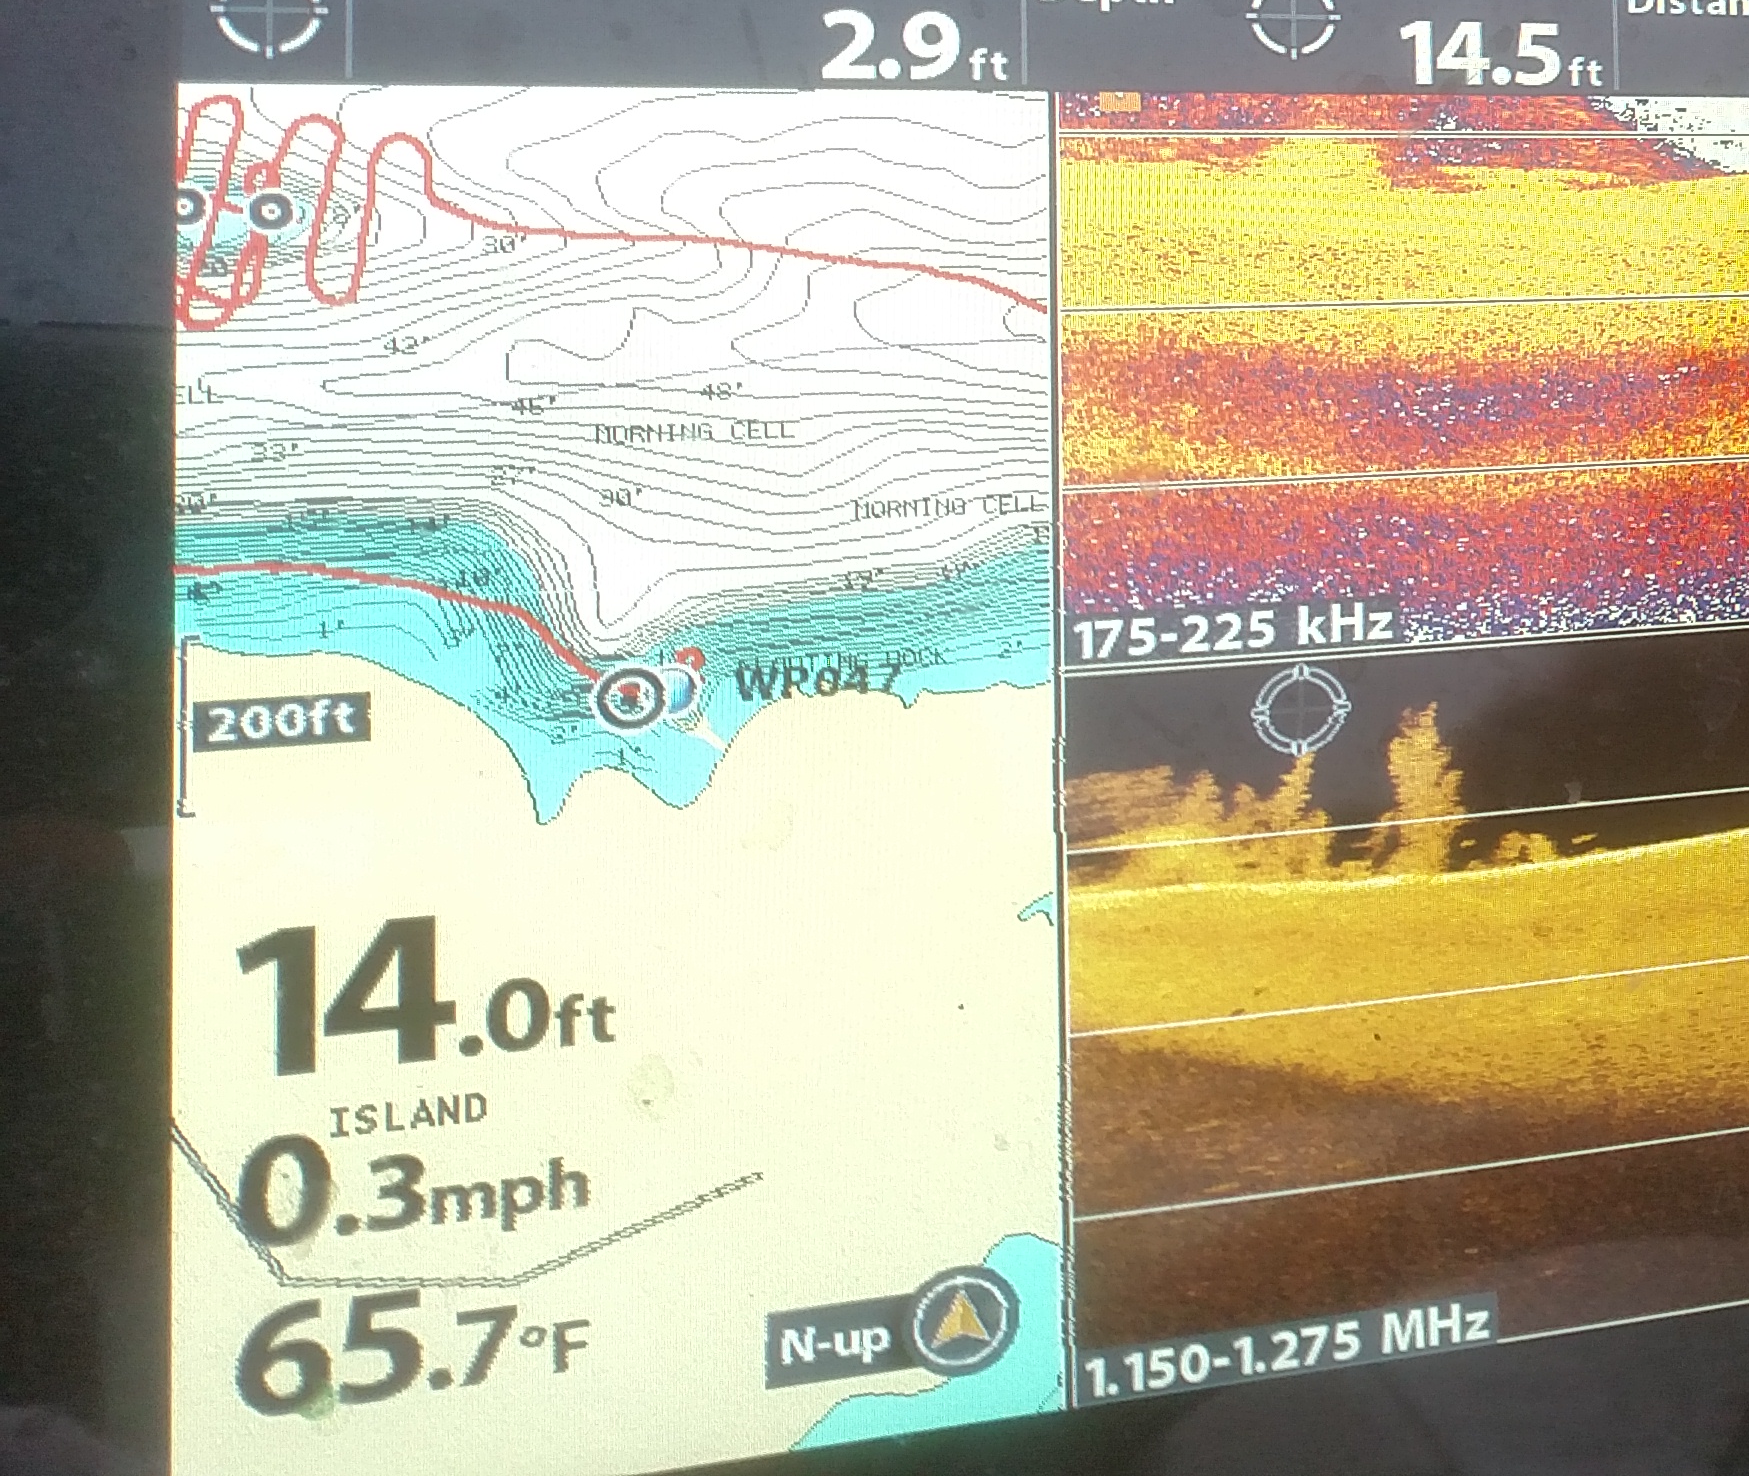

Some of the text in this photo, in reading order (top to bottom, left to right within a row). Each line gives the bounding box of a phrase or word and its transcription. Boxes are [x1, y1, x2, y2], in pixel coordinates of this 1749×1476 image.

[596, 420, 796, 446] MORNING CELL
[852, 494, 1044, 521] MORNING CELL
[1073, 602, 1395, 660] 175-225 kHz
[208, 698, 355, 743] 200ft
[330, 1092, 488, 1139] ISLAND
[779, 1322, 892, 1366] N-up
[1085, 1302, 1491, 1398] 1.150-1.275 MHz
